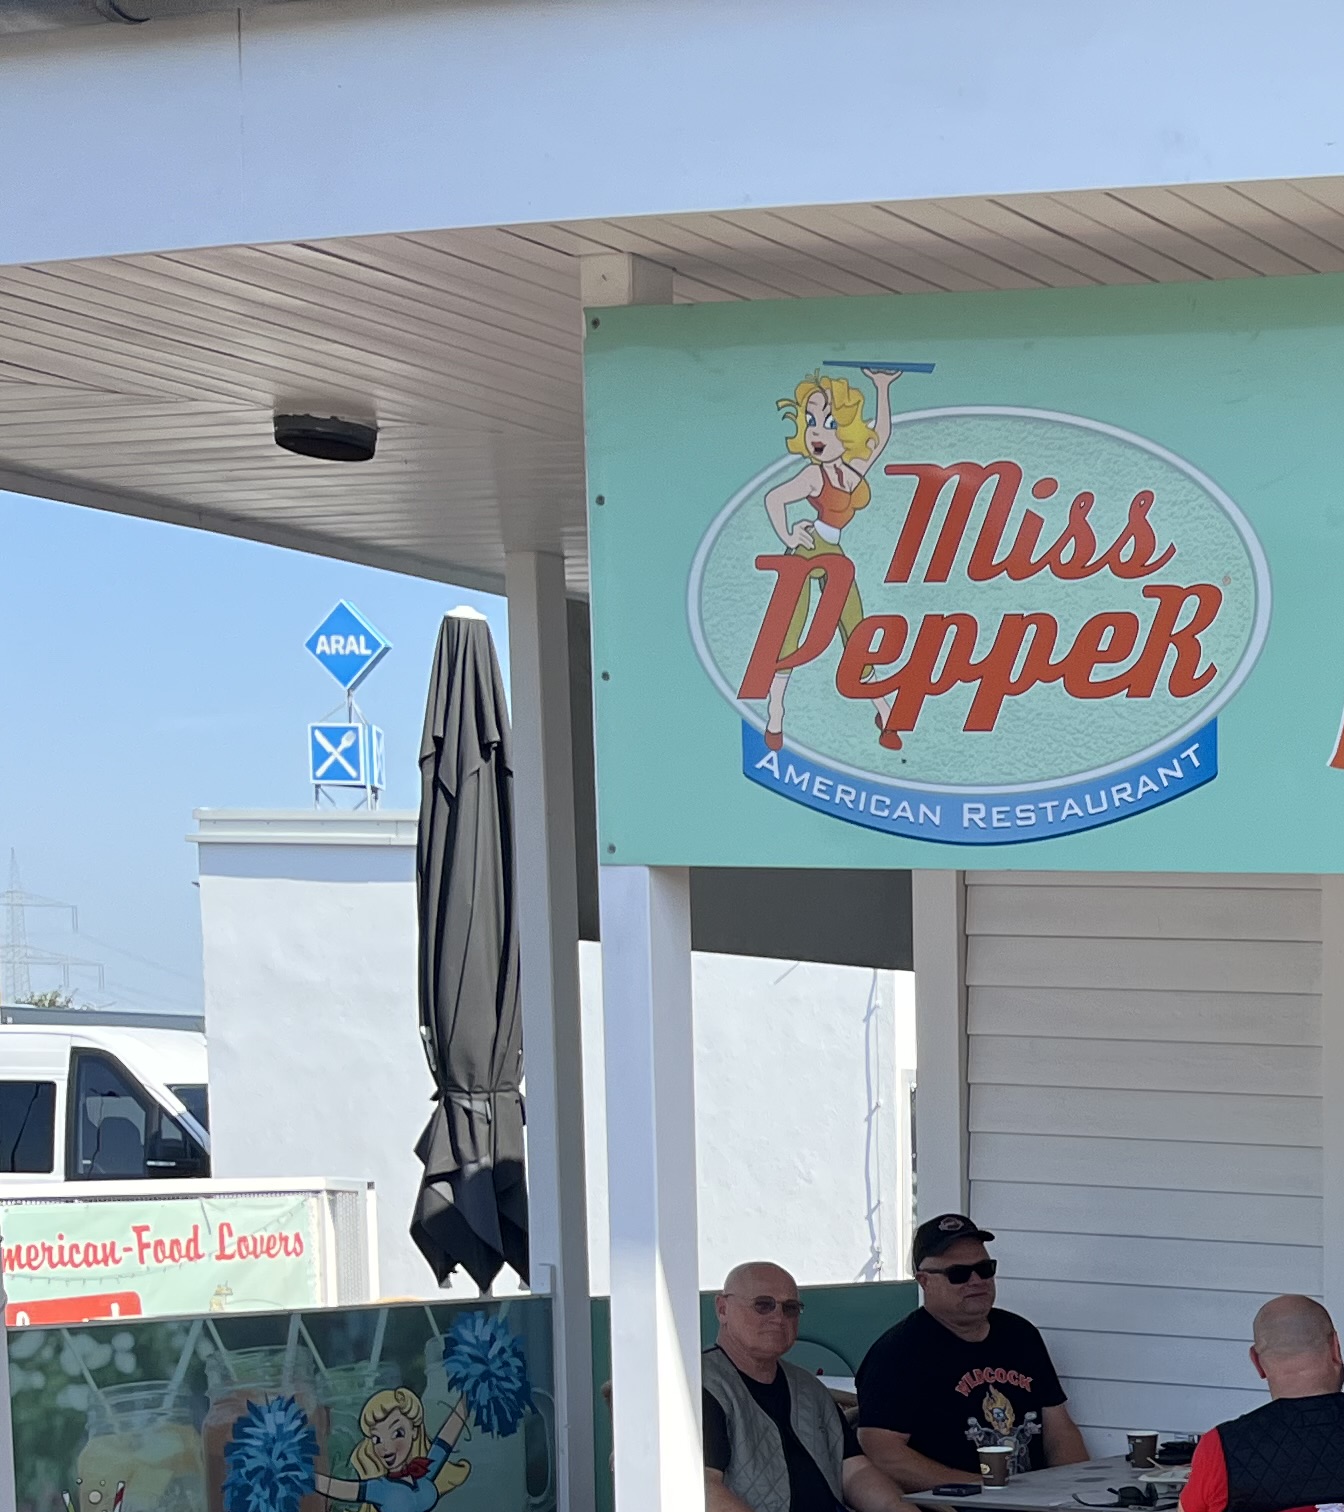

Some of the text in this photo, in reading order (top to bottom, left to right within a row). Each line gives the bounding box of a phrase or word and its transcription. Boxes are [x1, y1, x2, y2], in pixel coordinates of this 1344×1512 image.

[884, 461, 1177, 584] Miss
[315, 634, 373, 656] ARAL
[754, 742, 1204, 830] AMERICAN RESTAURANT
[1, 1221, 305, 1274] merican-Food Lovers
